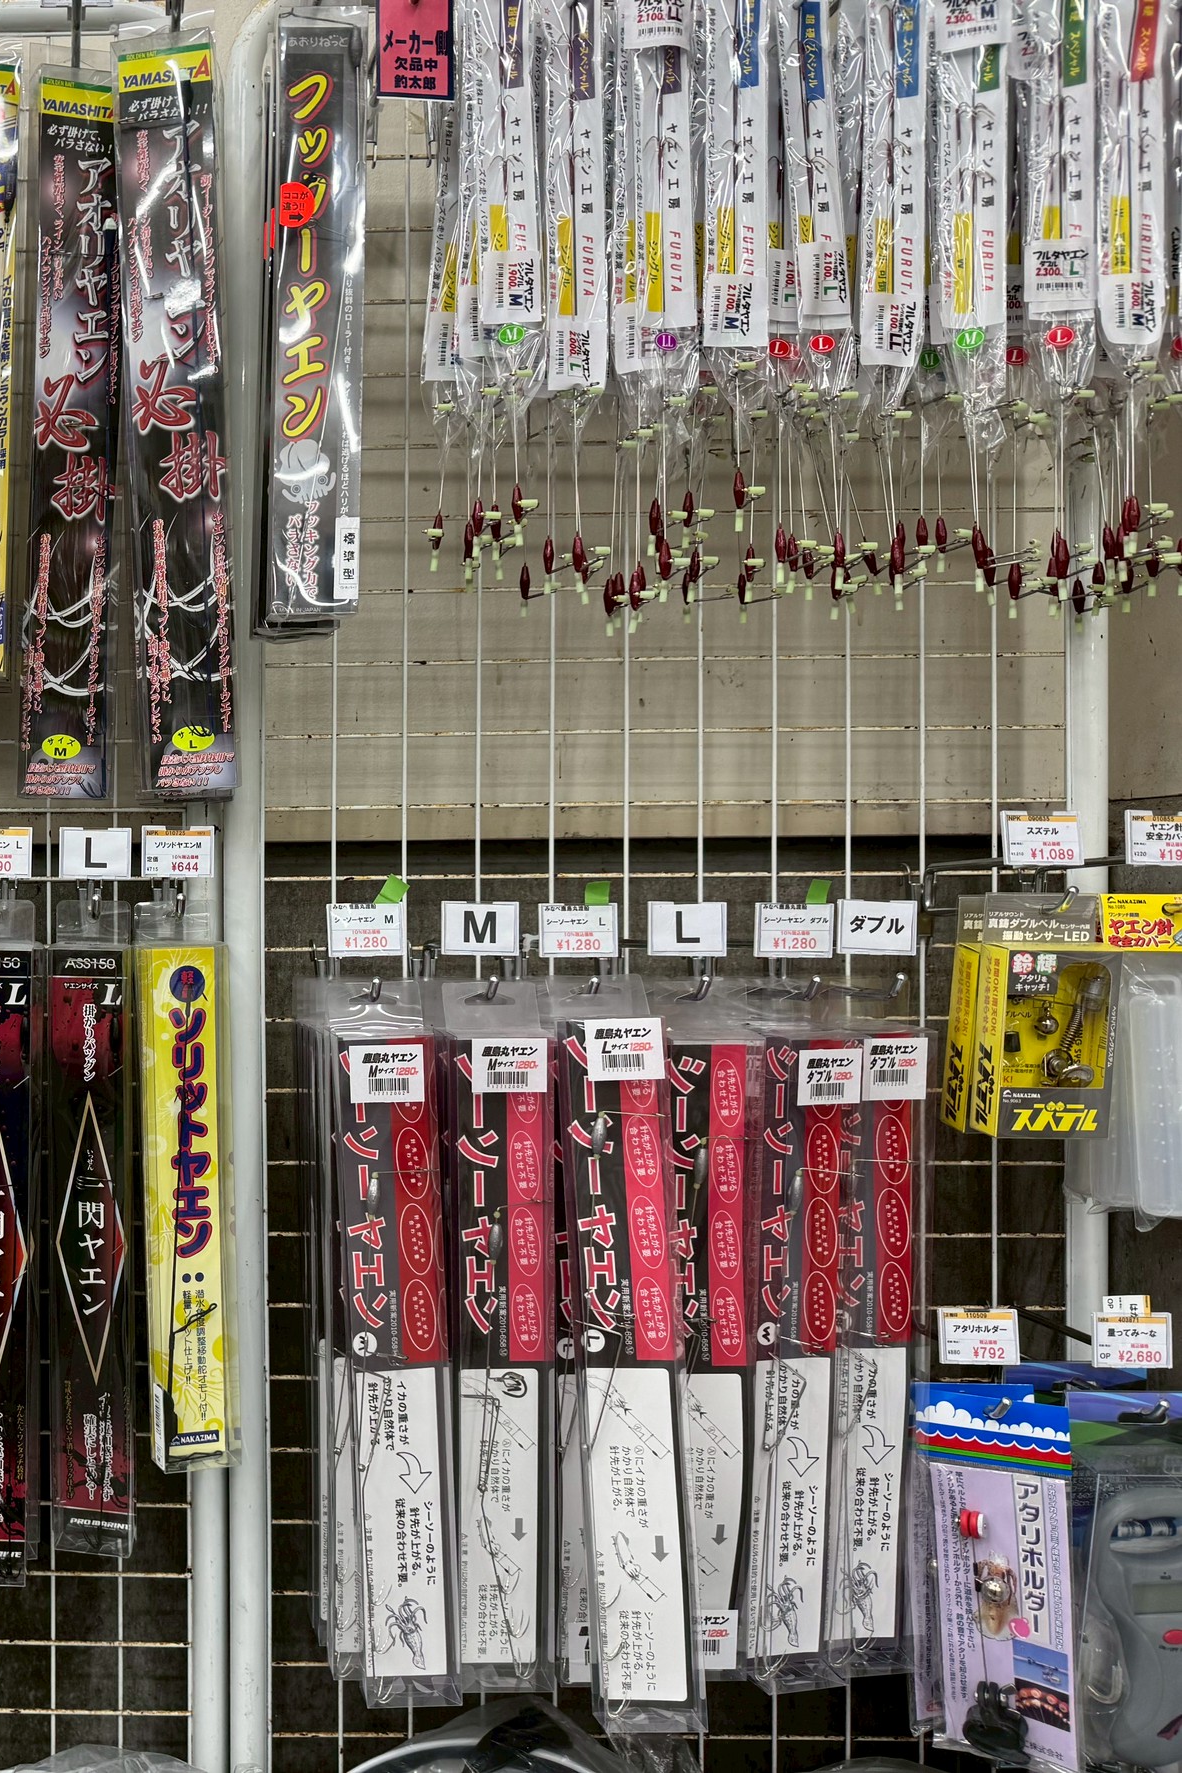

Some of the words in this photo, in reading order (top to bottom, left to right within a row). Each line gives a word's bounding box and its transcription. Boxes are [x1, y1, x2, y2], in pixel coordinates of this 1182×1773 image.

[394, 57, 438, 72] 欠品中
[394, 75, 436, 90] 釣太郎
[283, 192, 309, 200] ココが
[581, 234, 595, 298] FURUTA
[669, 230, 682, 293] FURUTA
[981, 229, 994, 293] FURUTA
[54, 746, 67, 757] M
[189, 740, 198, 750] L
[1027, 827, 1059, 835] スズテル
[16, 841, 23, 849] L
[85, 837, 107, 868] L
[172, 862, 199, 872] ¥644
[384, 915, 394, 924] M
[546, 917, 589, 926] シーソーヤエン
[849, 915, 905, 935] ダブル
[463, 911, 497, 944] M
[675, 911, 700, 944] L
[1108, 918, 1174, 935] ヤエン針
[1108, 935, 1171, 947] 安全カバー
[1019, 975, 1047, 983] アタリを
[5, 983, 27, 1006] L
[952, 1324, 1008, 1333] アタリホルダー
[973, 1347, 1005, 1359] ¥792
[1017, 1480, 1046, 1633] アタリホルダー
